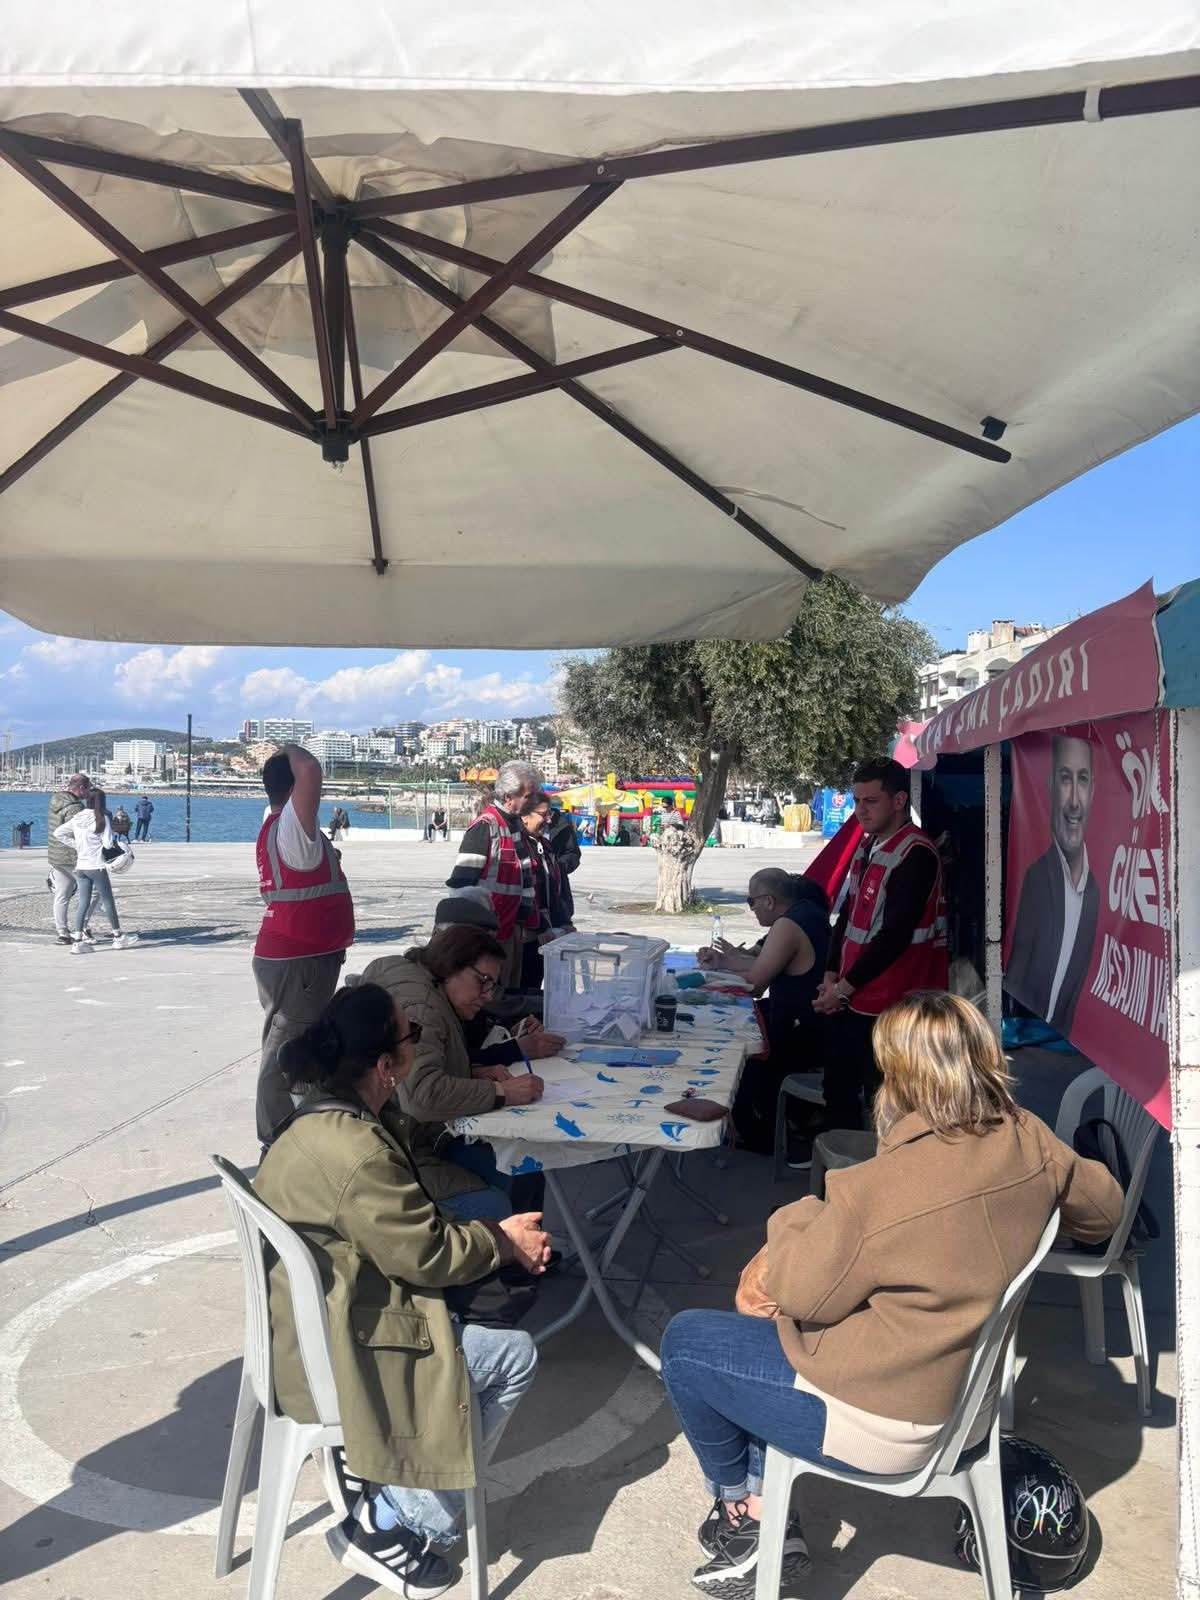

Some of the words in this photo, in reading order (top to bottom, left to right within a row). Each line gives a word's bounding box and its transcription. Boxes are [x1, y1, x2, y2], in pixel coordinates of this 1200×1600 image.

[998, 637, 1093, 734] ÇADIRI
[1090, 932, 1152, 1027] MESAJIM
[1150, 955, 1171, 1044] VA
